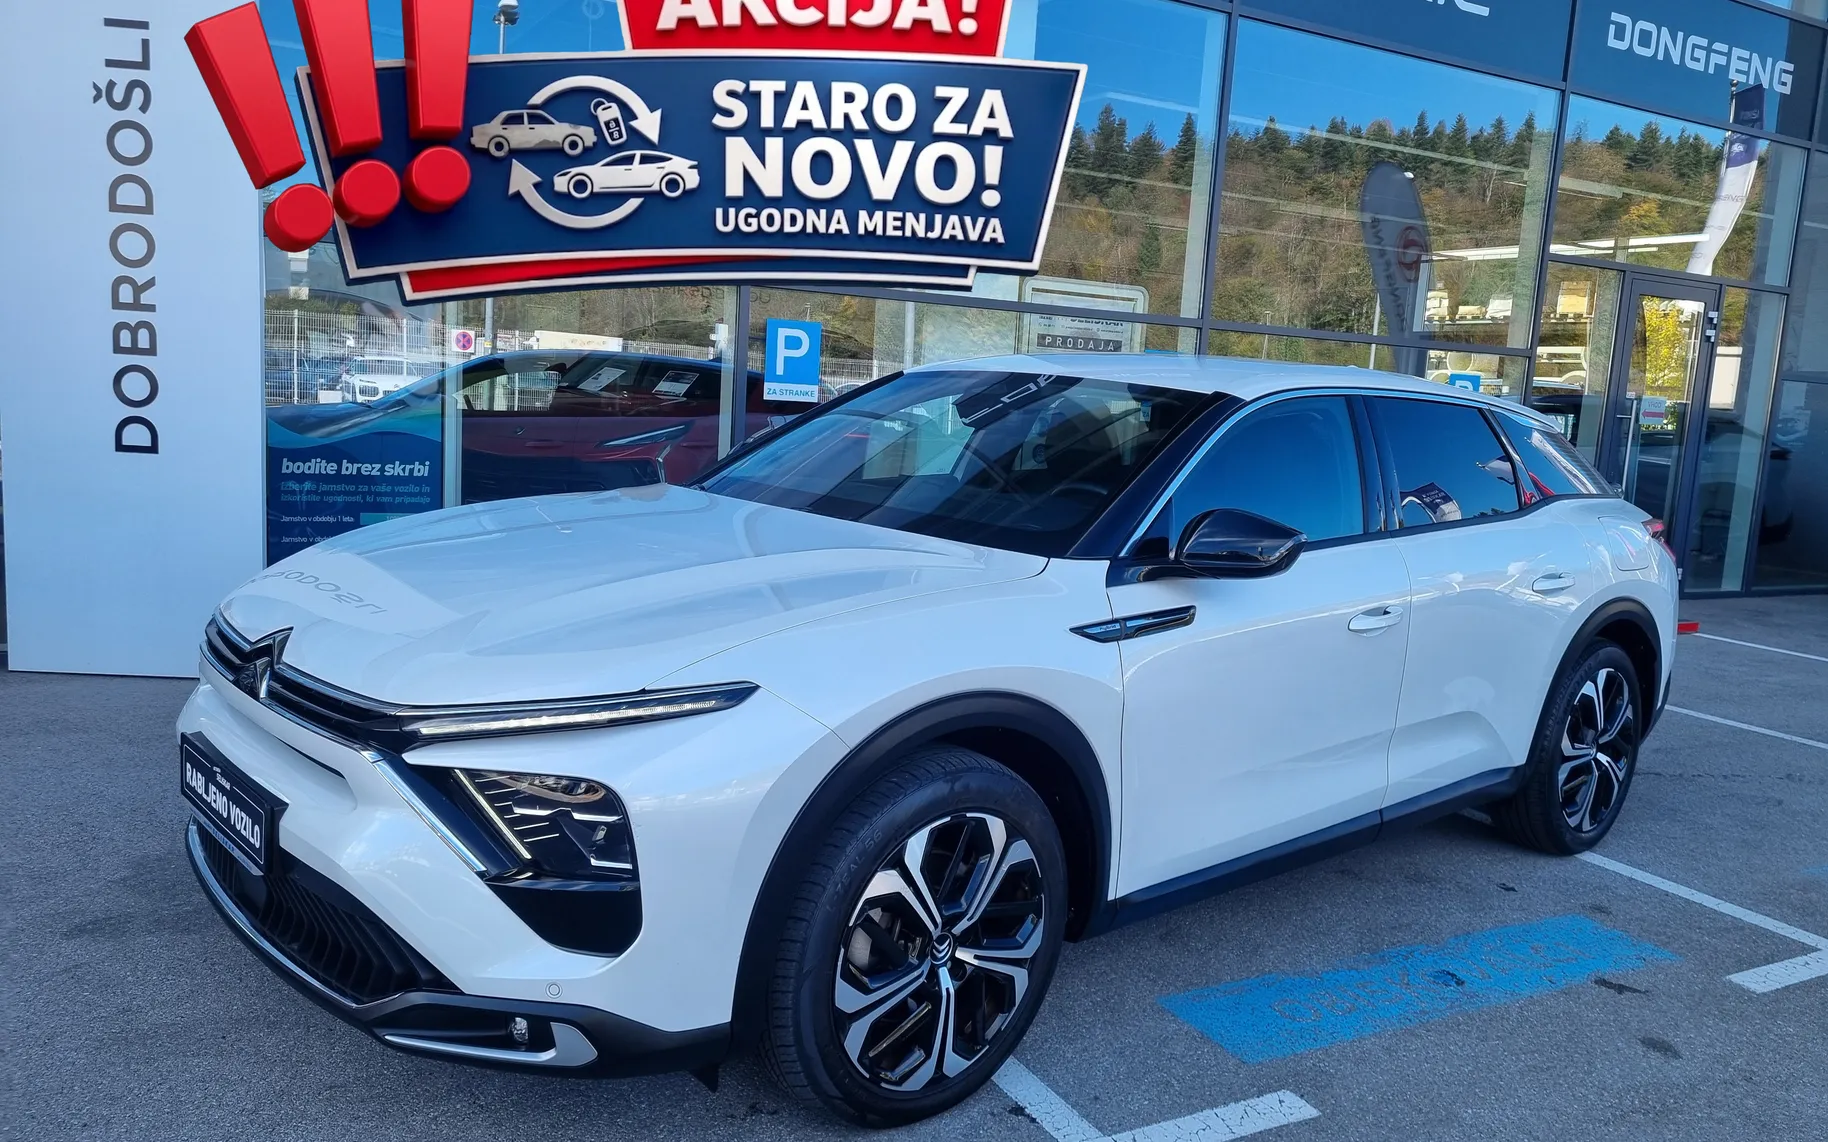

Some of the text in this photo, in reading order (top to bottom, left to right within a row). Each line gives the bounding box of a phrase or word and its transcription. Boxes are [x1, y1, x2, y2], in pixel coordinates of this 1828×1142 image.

[1607, 12, 1795, 95] DONGFENG
[93, 17, 159, 454] DOBRODOŠLI
[775, 327, 810, 376] P
[1045, 336, 1115, 351] PRODAJA
[766, 387, 815, 397] ZA STRANKE
[281, 457, 430, 477] bodite brez skrbi
[318, 482, 356, 493] jamstvo
[370, 483, 392, 493] vaše
[394, 483, 420, 493] vozilo
[421, 484, 430, 493] in
[366, 494, 374, 503] ki
[376, 495, 393, 503] vam
[395, 495, 430, 504] pripadajo
[281, 515, 307, 523] Jamstvo
[313, 515, 337, 523] obdobju
[187, 762, 228, 818] RABLJENO
[229, 800, 261, 849] VOZILO
